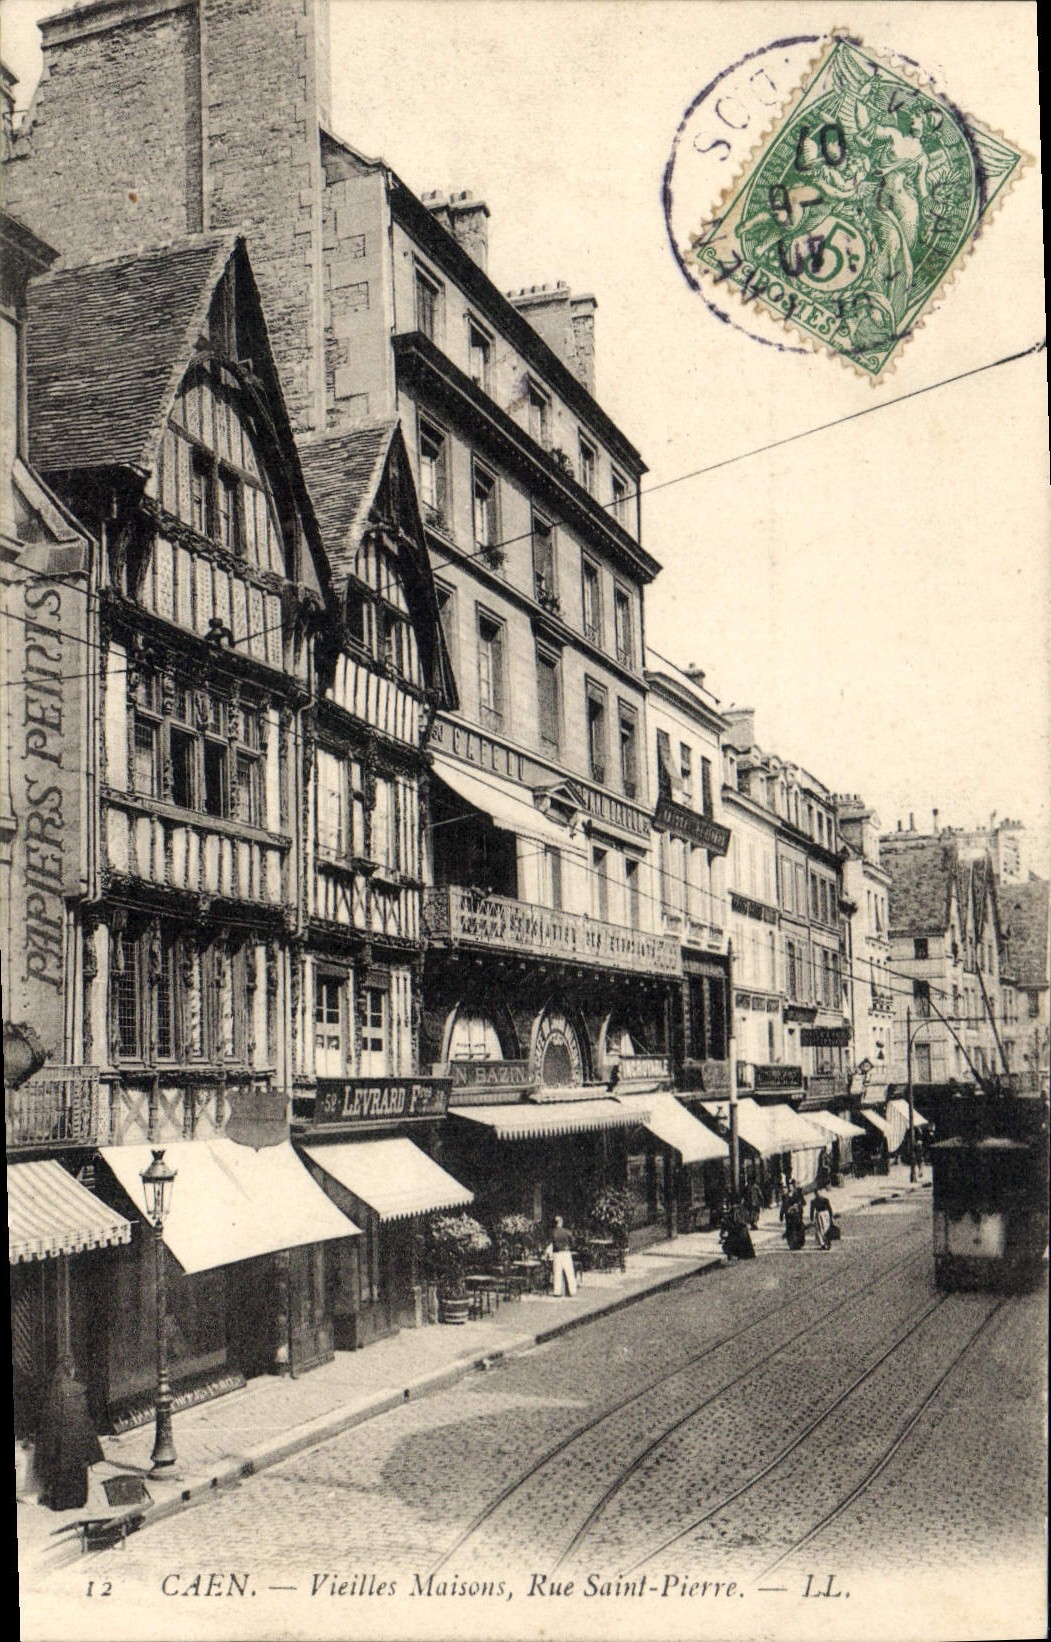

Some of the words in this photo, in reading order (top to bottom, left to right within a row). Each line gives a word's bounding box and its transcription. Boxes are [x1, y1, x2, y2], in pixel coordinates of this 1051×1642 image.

[753, 267, 840, 336] POSTES
[21, 583, 65, 769] PEINTS
[21, 774, 65, 994] PAPIERS
[341, 1085, 406, 1116] LEVRARD
